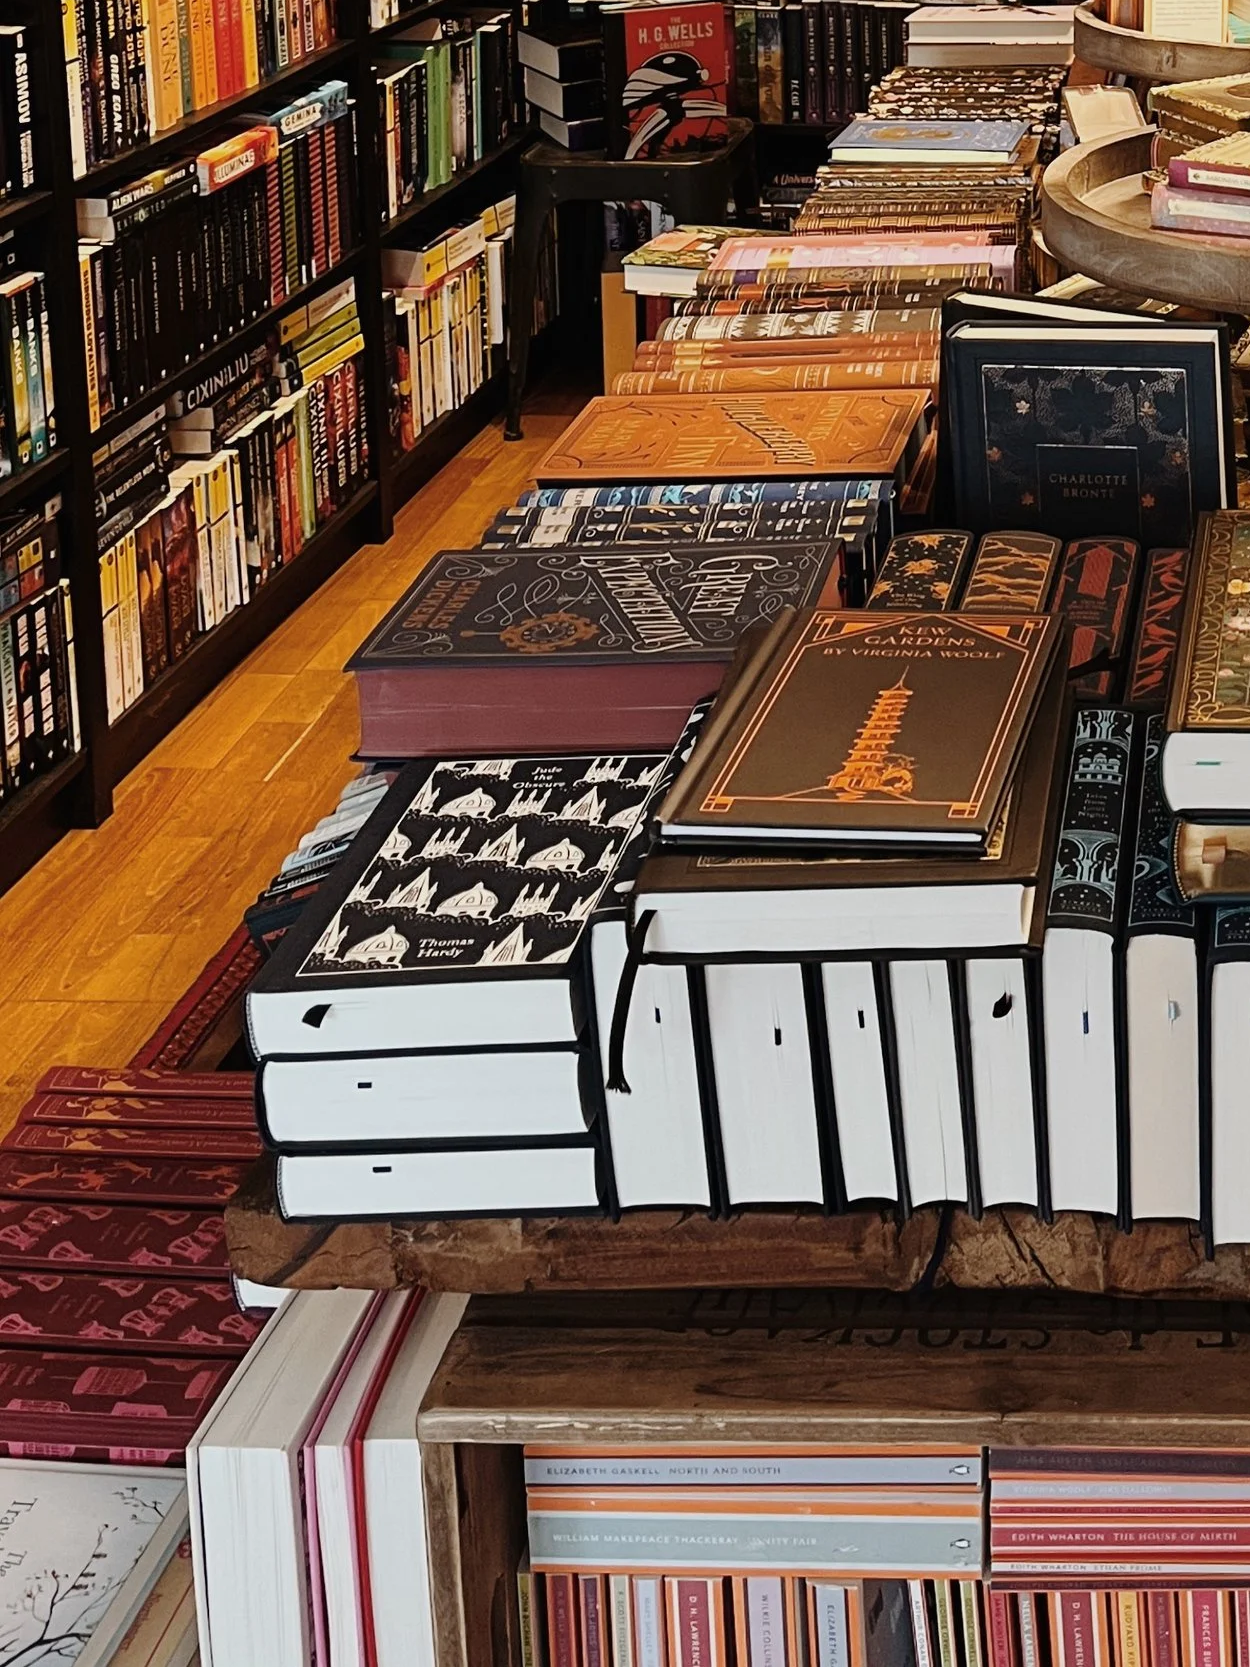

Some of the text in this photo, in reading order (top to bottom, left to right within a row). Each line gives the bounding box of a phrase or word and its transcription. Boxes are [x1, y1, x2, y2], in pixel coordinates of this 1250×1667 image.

[638, 22, 713, 44] H. G. WELLS
[15, 53, 31, 123] ASIMOV
[284, 106, 318, 127] GEMINA
[111, 183, 155, 213] ALIEN WARS
[1048, 473, 1128, 486] CHARLOTTE
[681, 555, 782, 619] GREAT
[402, 580, 443, 630] DICKENS
[428, 580, 482, 630] CHARLES
[579, 551, 706, 654] EXPECTATIONS
[900, 625, 953, 635] KEW
[864, 636, 976, 647] GARDENS
[823, 648, 1005, 660] BY VIRGINIA WOOLF
[531, 765, 563, 776] Jude
[512, 781, 566, 790] Obscure
[416, 946, 465, 959] Hardy
[418, 936, 476, 949] Thomas
[546, 1467, 782, 1476] ELIZABETH GASKELL NORTH AND SOUTH
[552, 1534, 738, 1545] WILLIAM MAKEPEACE THACKERAY
[1011, 1532, 1237, 1542] EDITH WHARTON THE HOUSE OF MIRTH
[761, 1593, 770, 1627] WILKIE
[827, 1604, 838, 1657] ELIZABETH
[1124, 1604, 1134, 1649] RUDYARD
[1201, 1604, 1211, 1648] FRANCES
